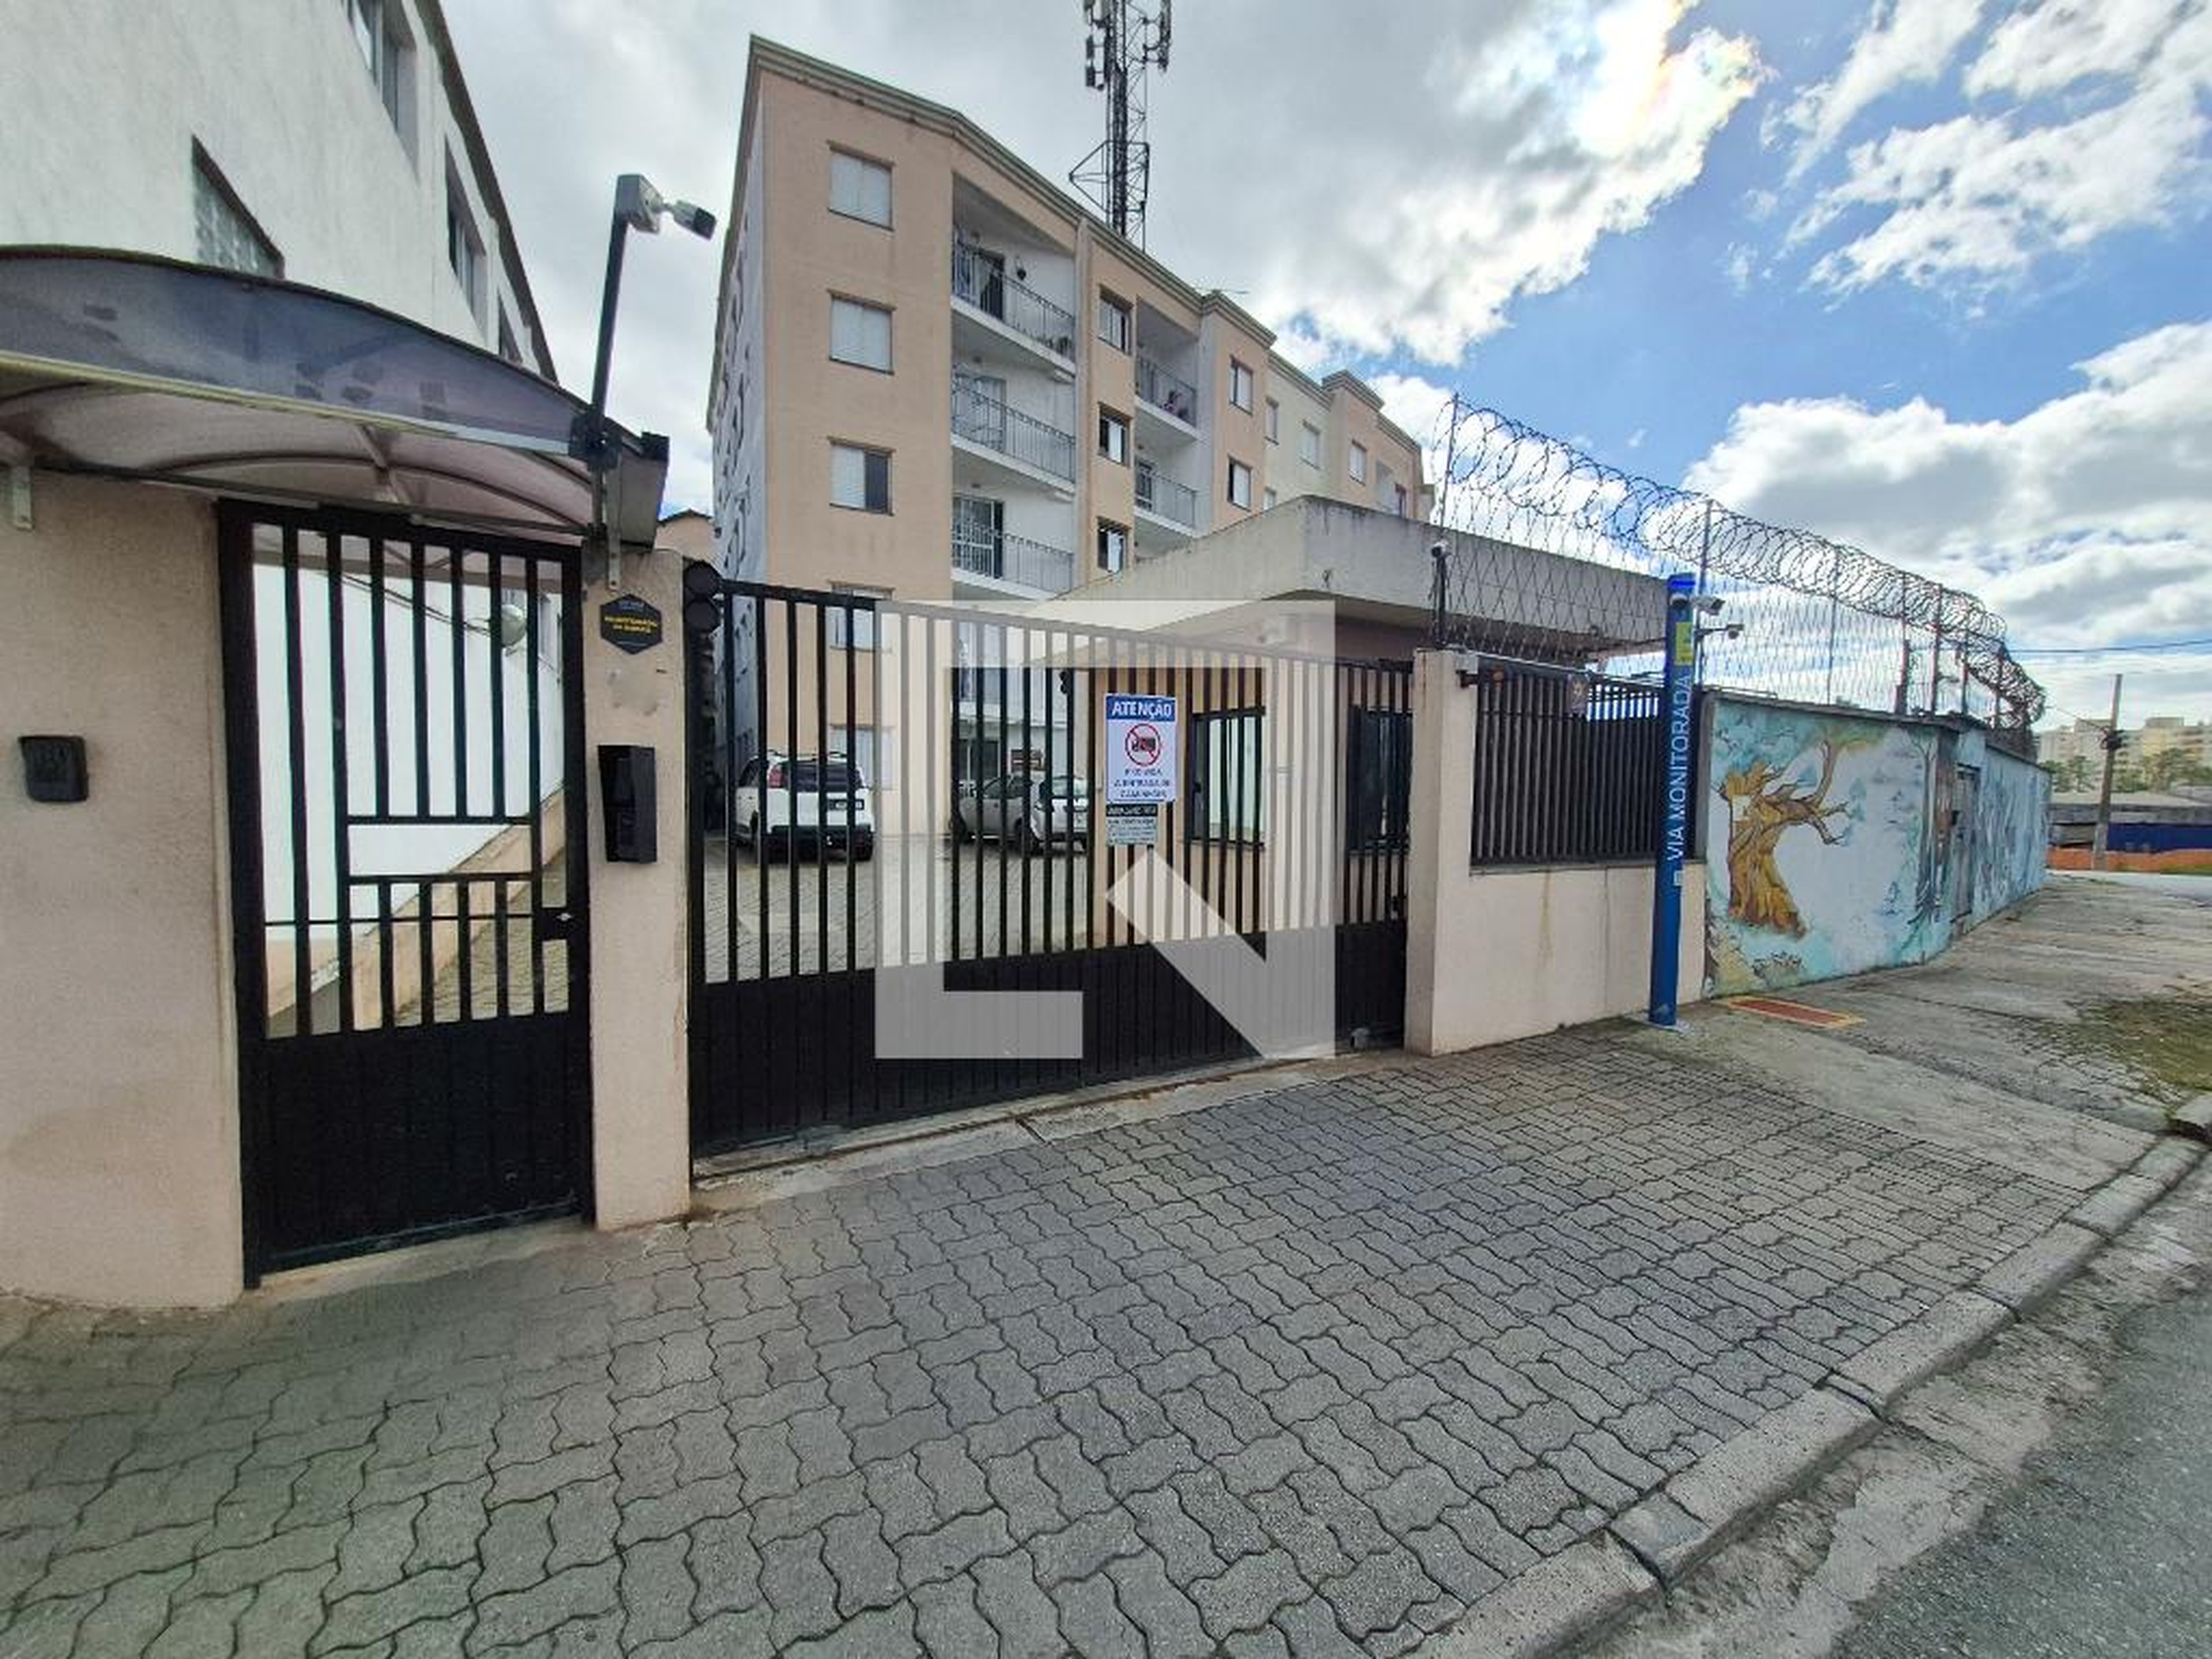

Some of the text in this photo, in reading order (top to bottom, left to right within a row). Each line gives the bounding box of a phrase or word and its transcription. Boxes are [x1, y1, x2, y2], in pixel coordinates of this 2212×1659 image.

[1112, 699, 1172, 719] ATENÇÃO
[1668, 674, 1692, 820] MONITORADA
[1666, 826, 1684, 861] VIA
